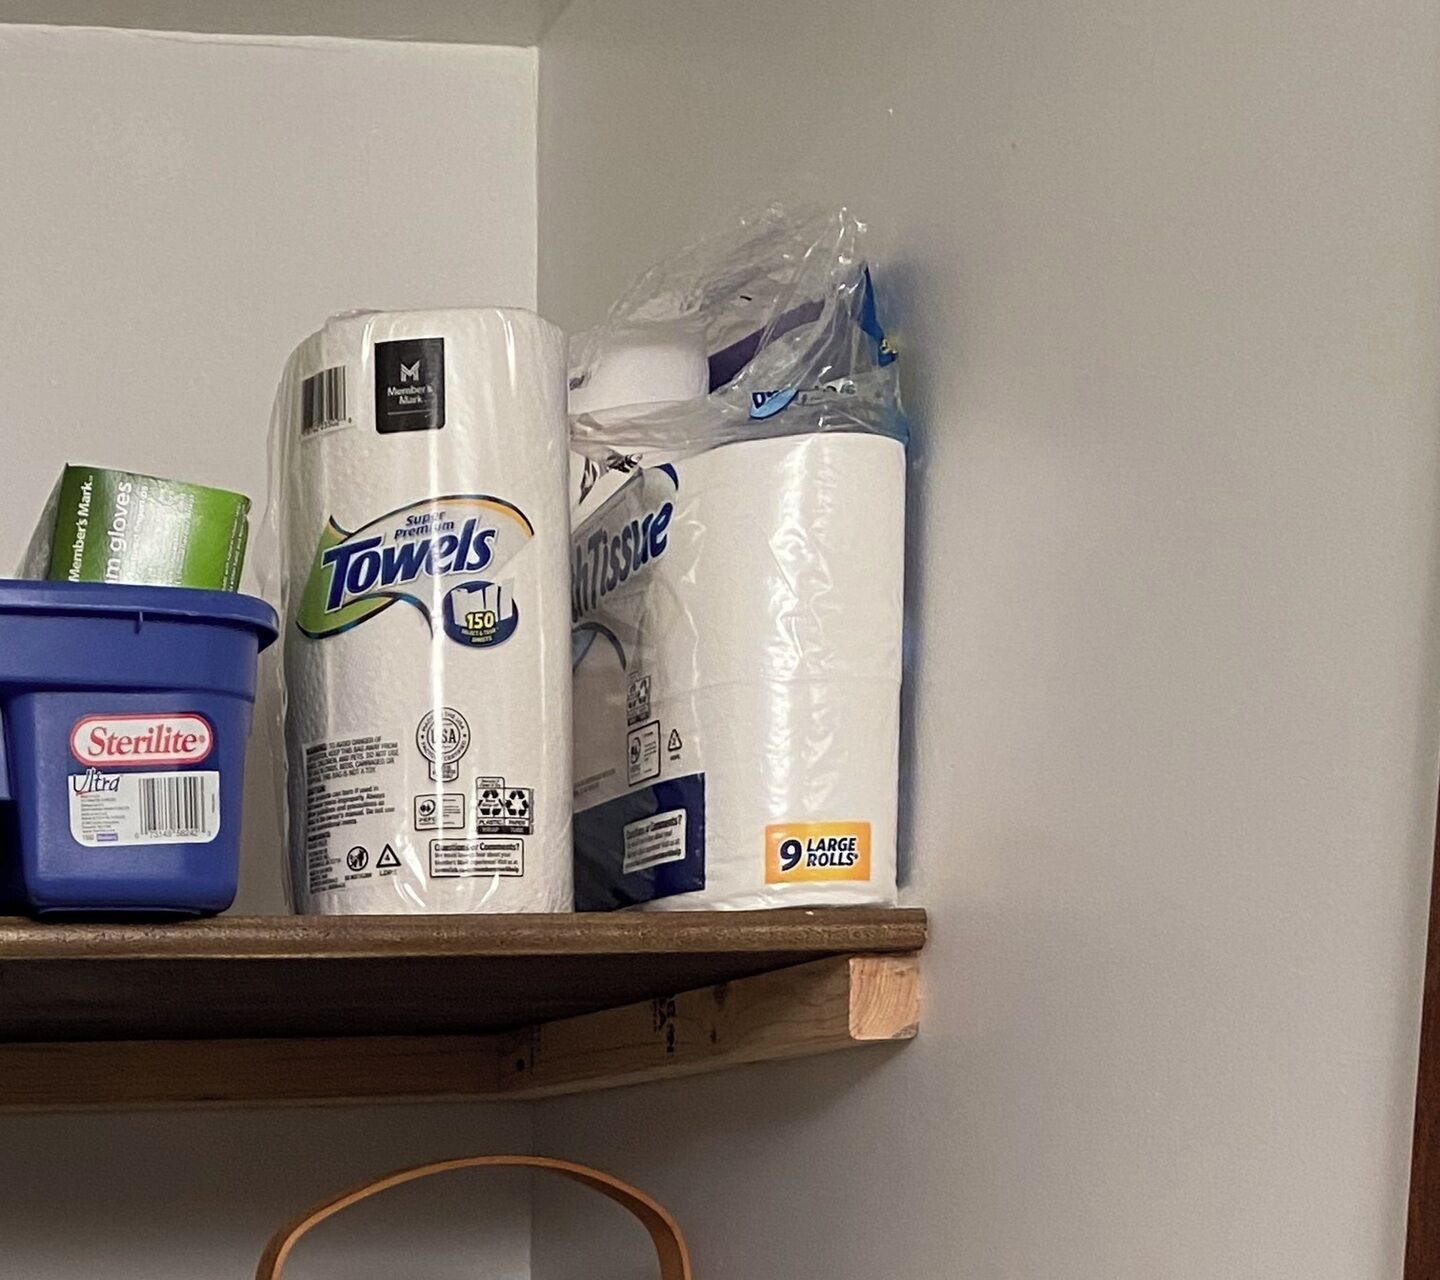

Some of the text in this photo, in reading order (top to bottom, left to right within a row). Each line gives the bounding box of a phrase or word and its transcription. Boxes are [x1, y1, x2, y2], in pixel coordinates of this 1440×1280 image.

[68, 481, 93, 583] Member's Mark
[107, 481, 133, 553] gloves
[322, 517, 496, 612] Towels
[465, 610, 496, 630] 150
[88, 723, 198, 756] Sterilite
[73, 767, 120, 792] Ultra
[779, 837, 857, 872] 9 LARGE
